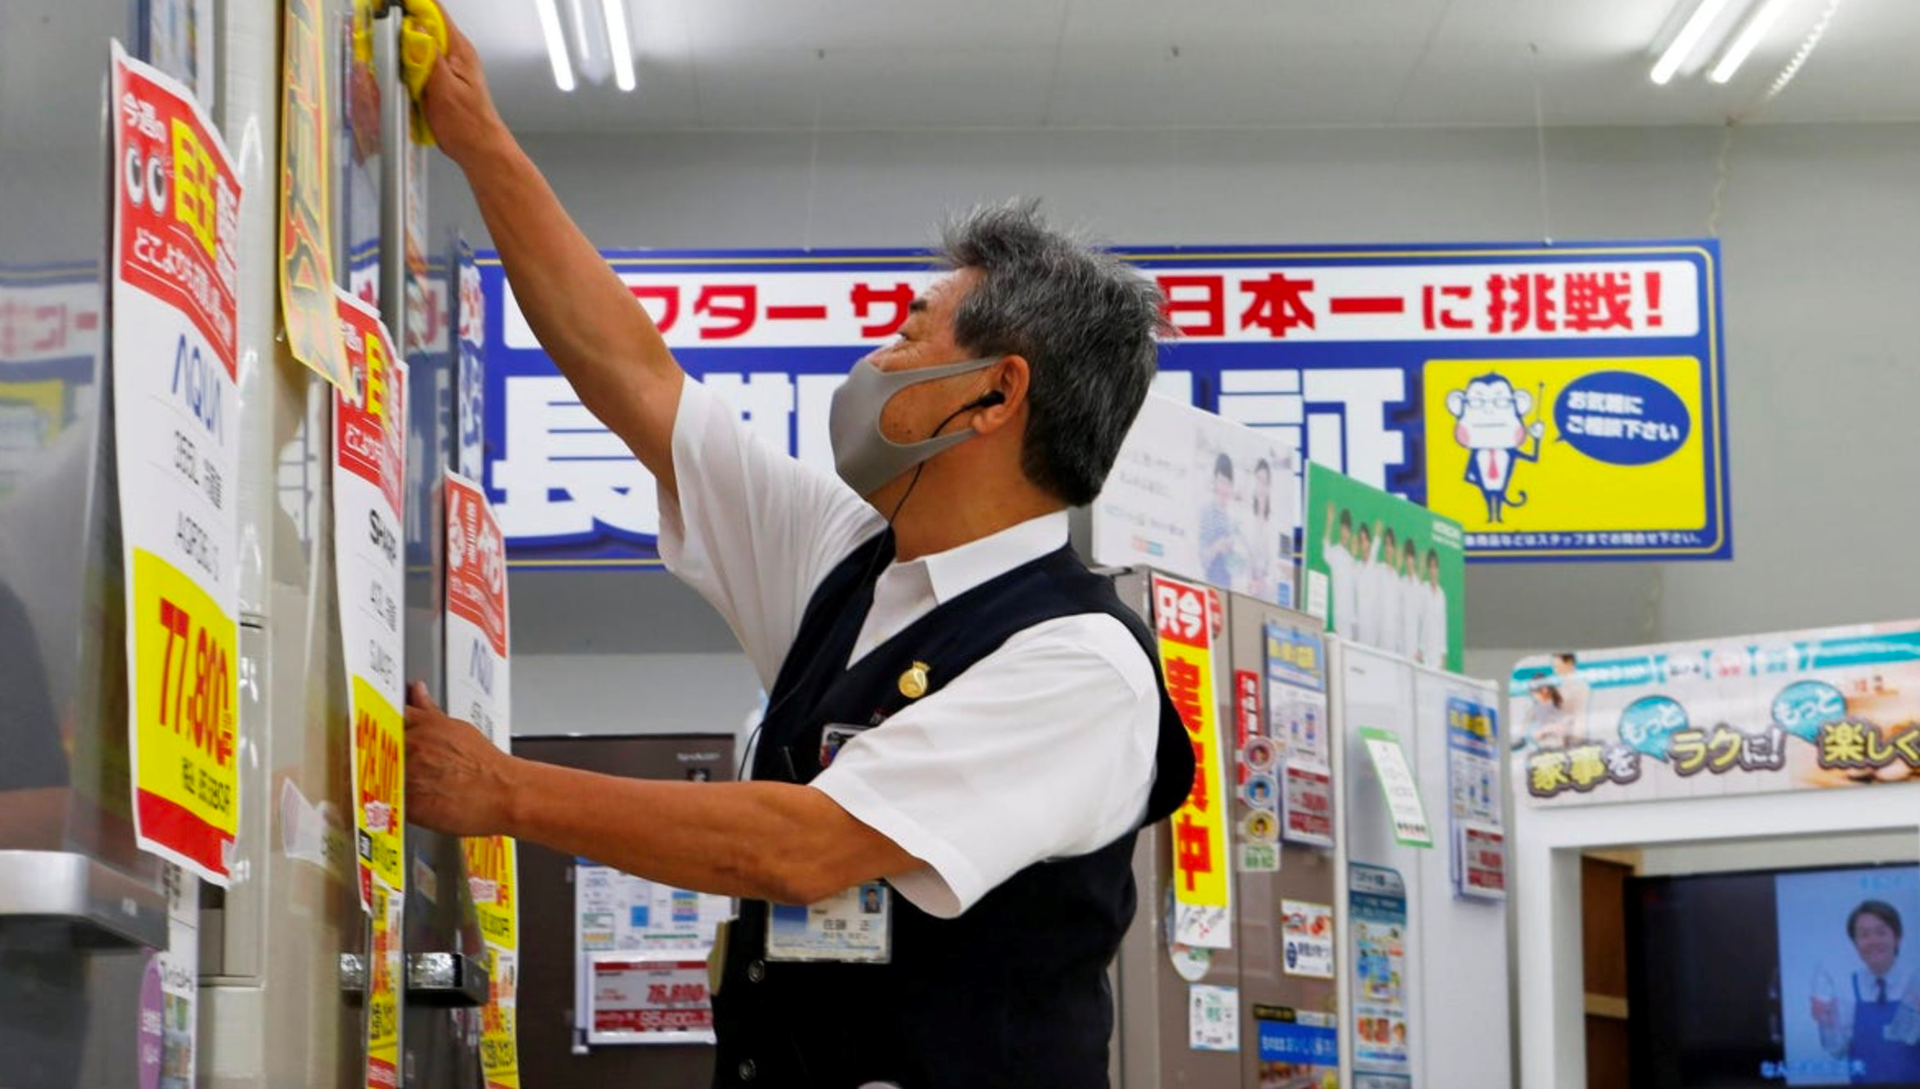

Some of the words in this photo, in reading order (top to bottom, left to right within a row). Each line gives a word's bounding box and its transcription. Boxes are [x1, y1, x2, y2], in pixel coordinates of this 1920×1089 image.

[1157, 270, 1664, 338] 日本一に挑戦!
[1156, 585, 1203, 639] 只今
[1621, 702, 1686, 742] もっと
[1773, 688, 1842, 724] もっと
[1530, 744, 1637, 792] 家事を
[1672, 728, 1782, 771] ラクに!
